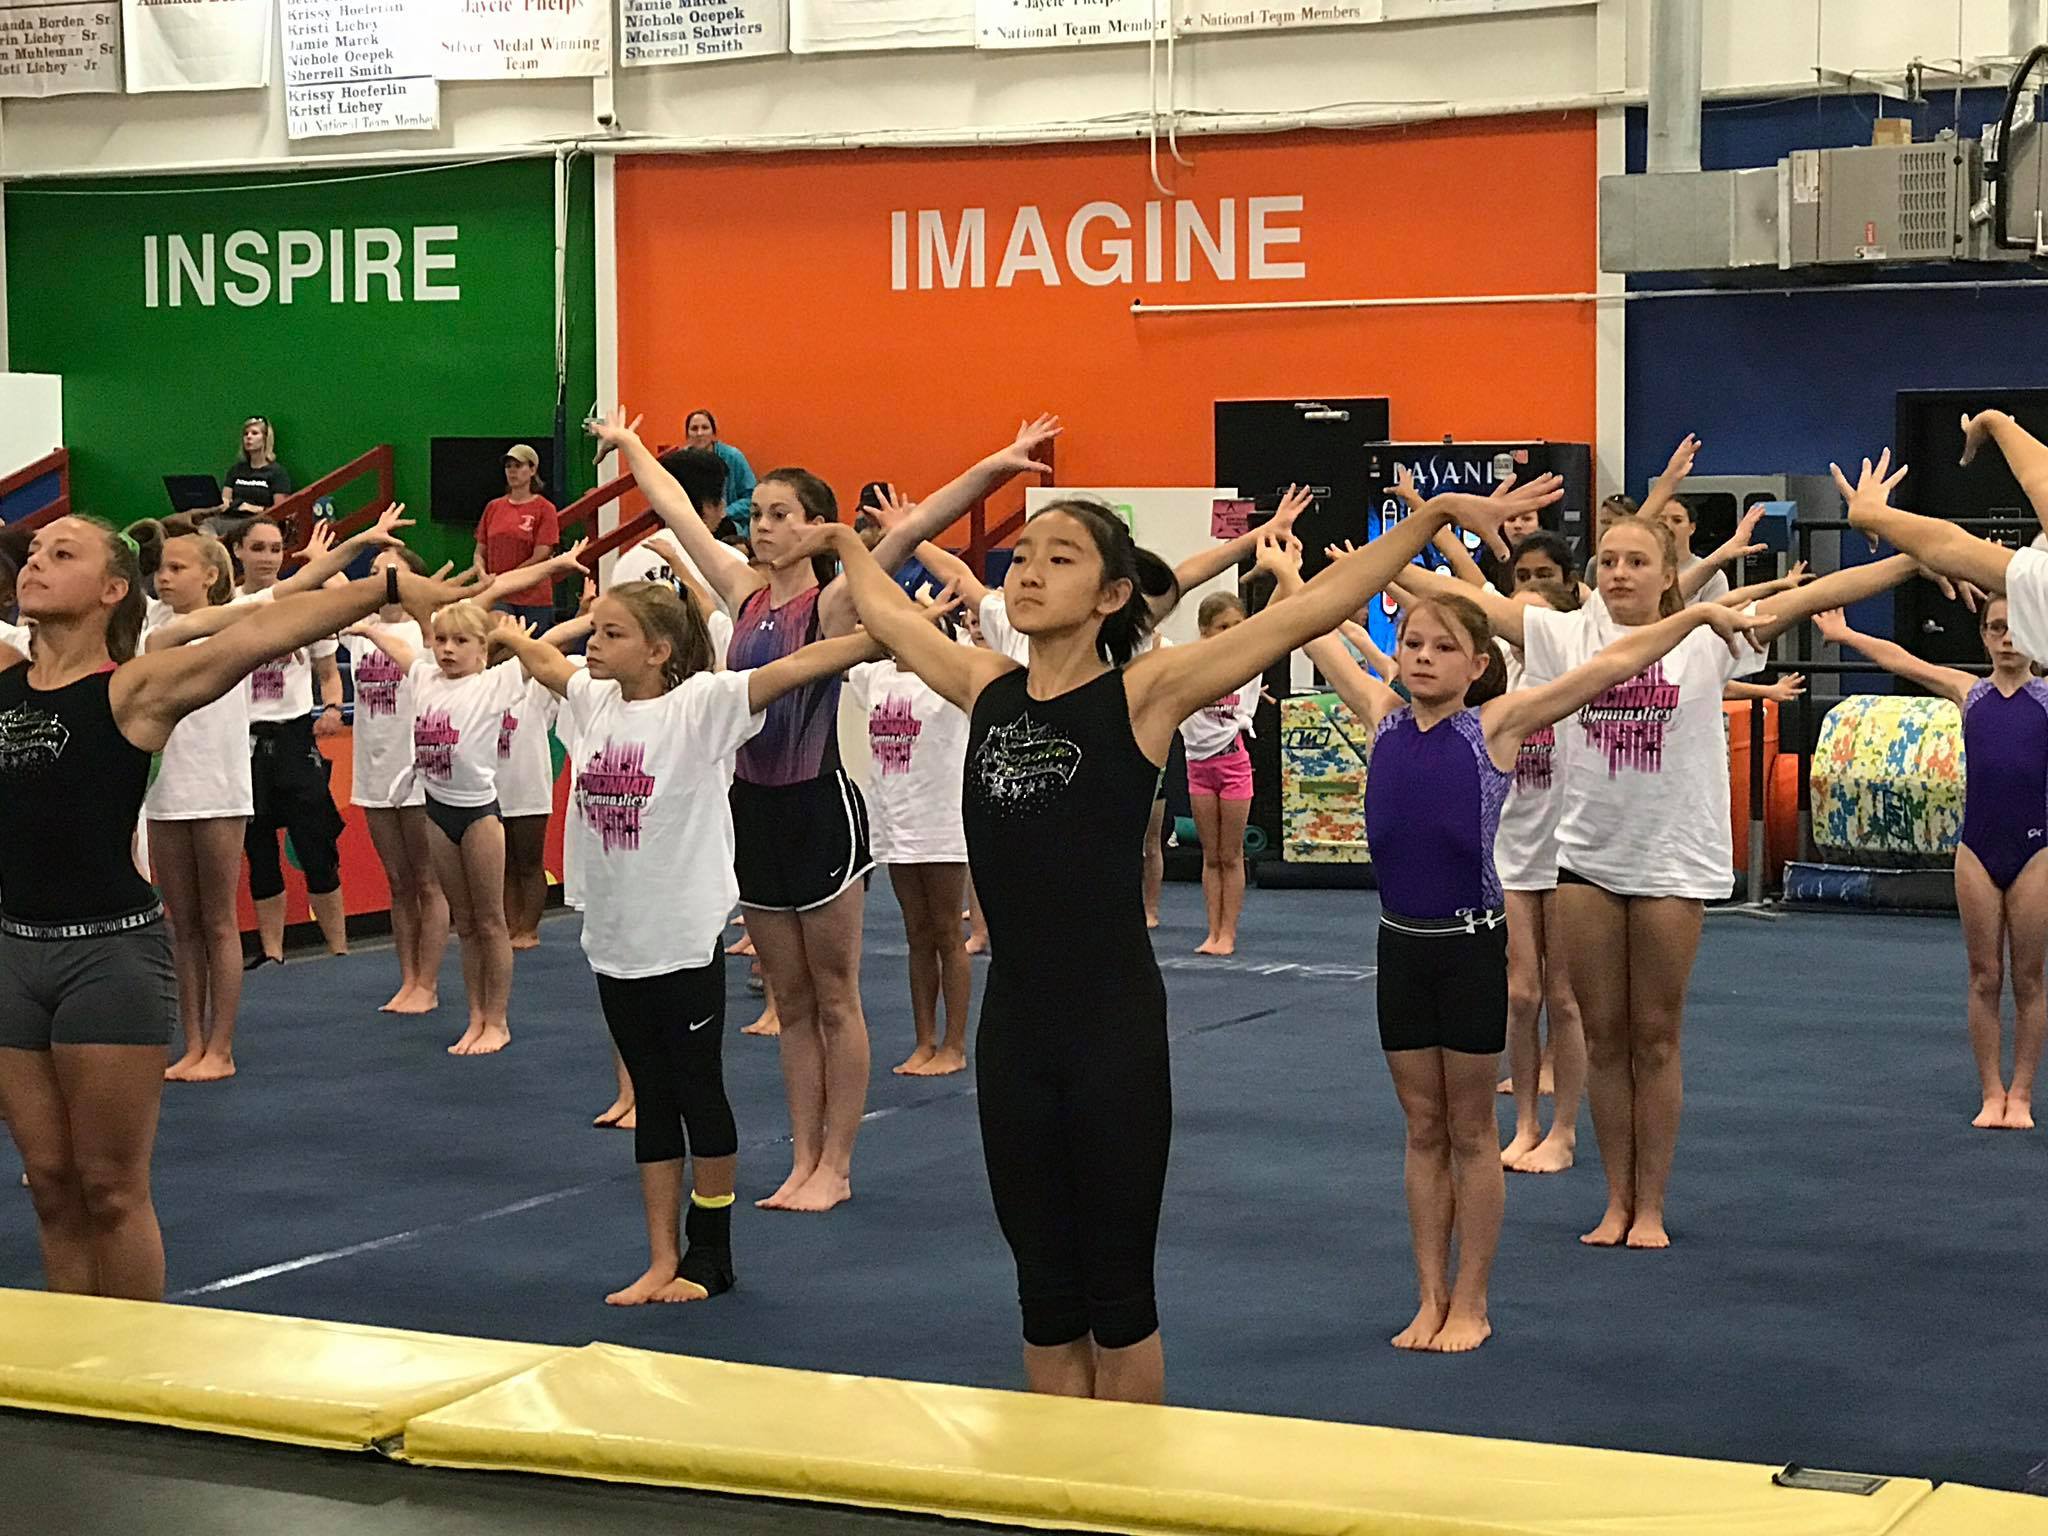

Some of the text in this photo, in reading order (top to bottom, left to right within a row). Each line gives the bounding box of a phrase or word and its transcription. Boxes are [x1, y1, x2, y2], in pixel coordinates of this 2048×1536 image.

[0, 19, 34, 31] anda
[39, 16, 85, 29] Borden
[625, 7, 744, 27] Nichole Ocepek
[1200, 6, 1361, 26] National Team Members
[288, 21, 330, 35] Kristi
[626, 23, 762, 43] Melissa Schwiers
[997, 24, 1057, 39] National
[1063, 22, 1101, 36] Team
[24, 32, 65, 45] Lichey
[493, 38, 534, 52] Medal
[540, 36, 601, 51] Winning
[15, 46, 84, 60] Muhleman
[344, 48, 394, 63] Ocepek
[625, 39, 743, 59] Sherrell Smith
[26, 60, 68, 75] Lichey
[349, 64, 393, 77] Smith
[504, 55, 539, 70] Team
[289, 83, 407, 102] Krissy Hoeferlin
[289, 101, 383, 117] Kristi Lichey
[891, 196, 1306, 290] IMAGINE
[144, 225, 460, 307] INSPIRE
[1580, 704, 1671, 724] Gymnastics
